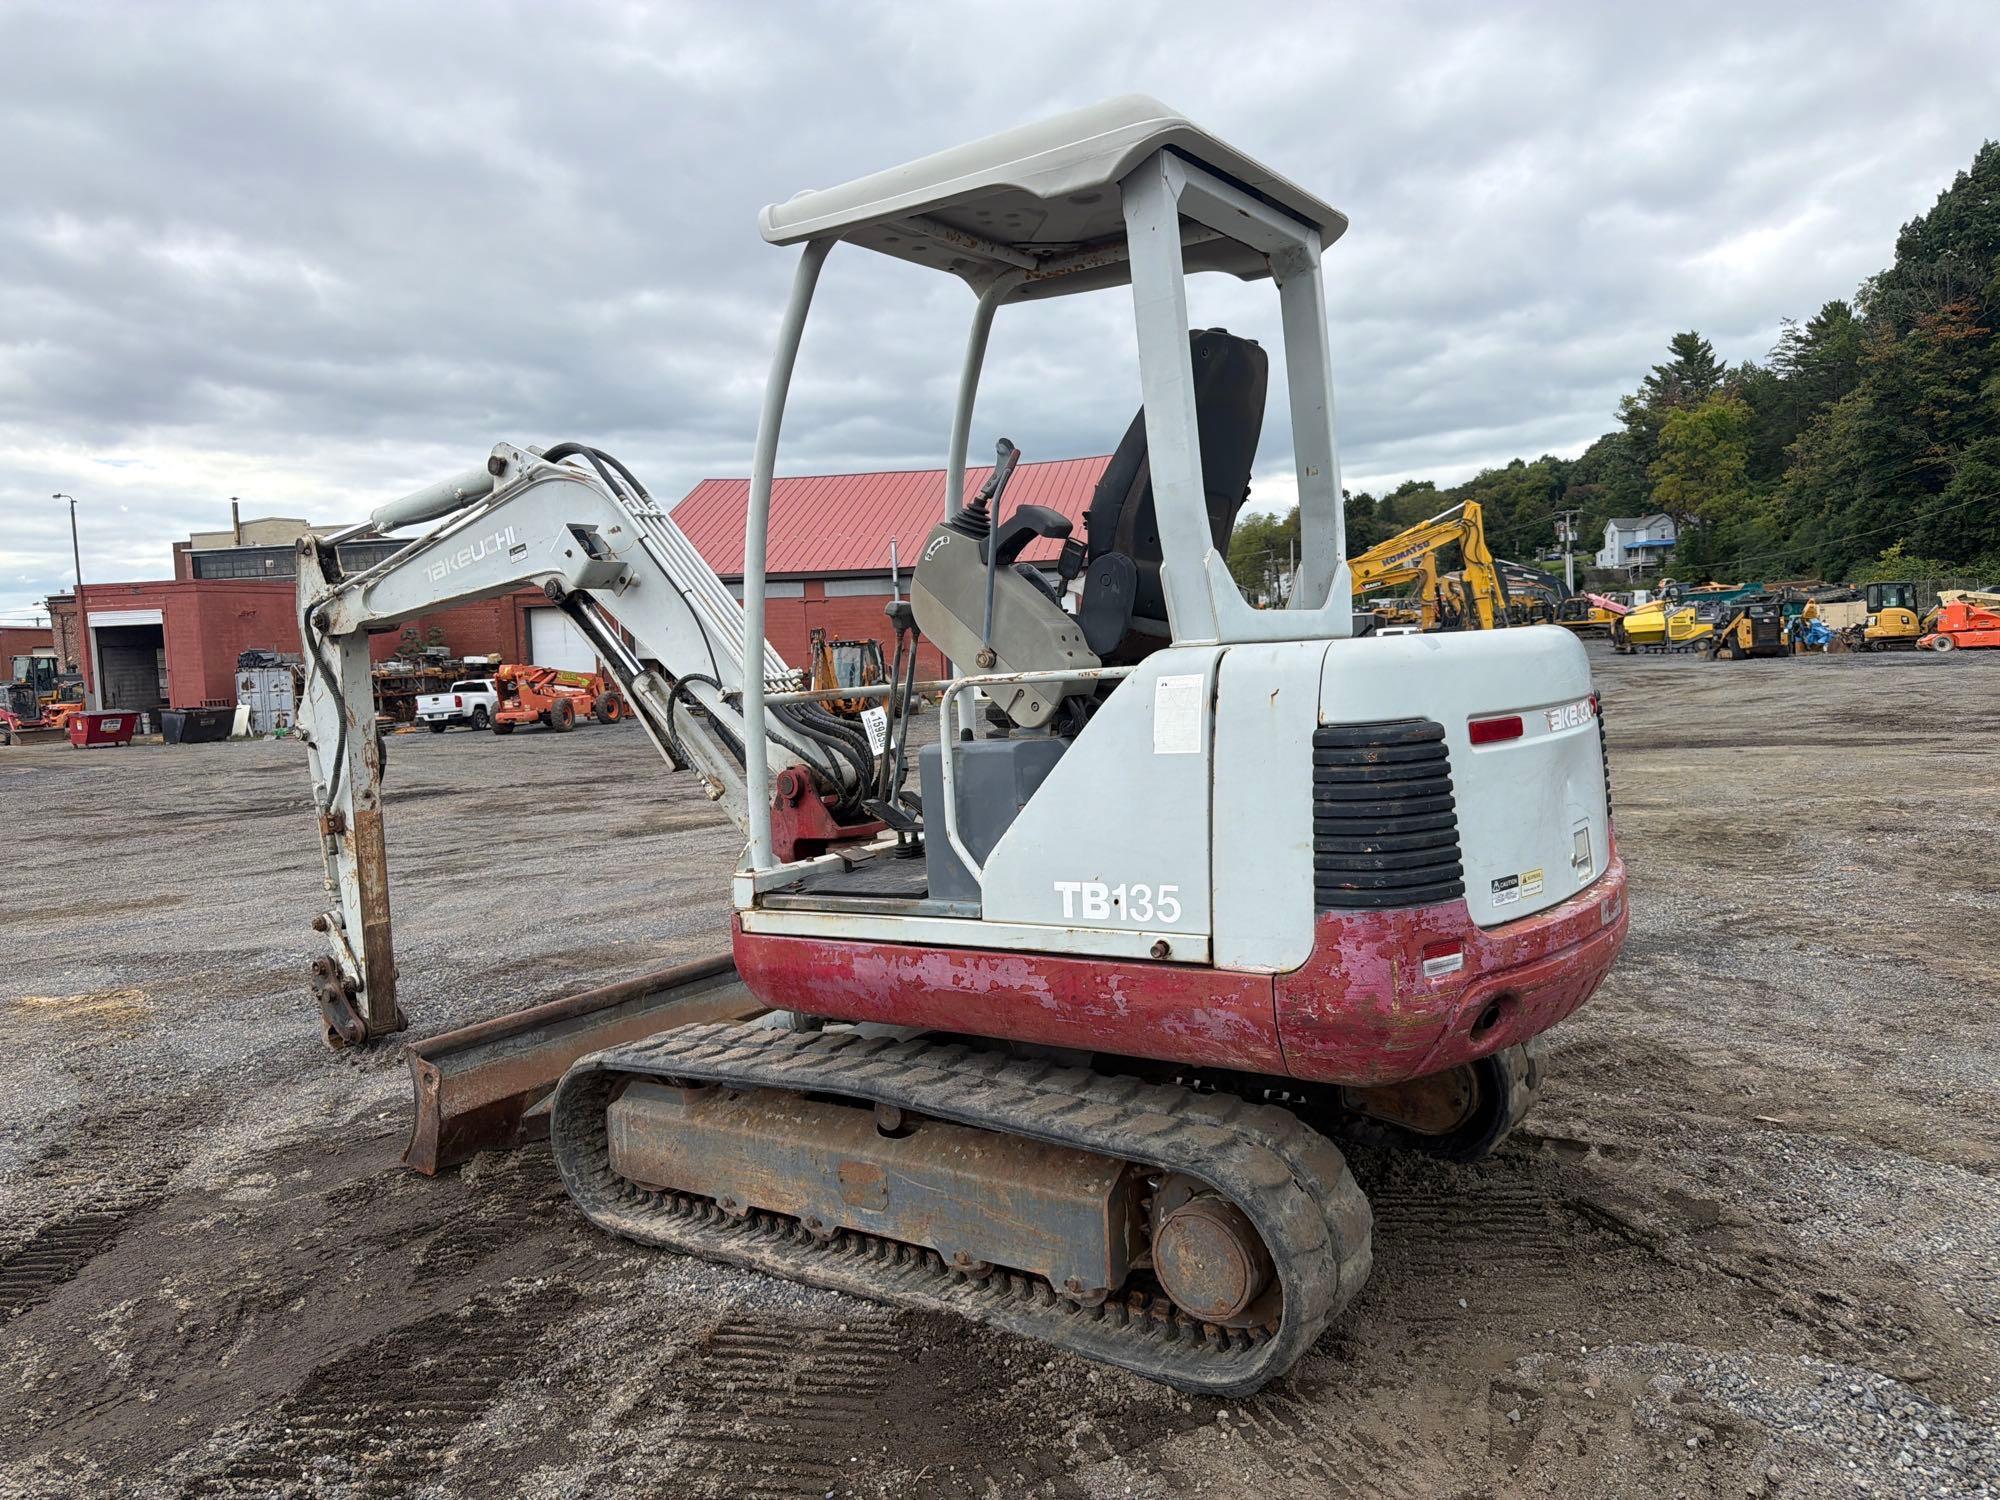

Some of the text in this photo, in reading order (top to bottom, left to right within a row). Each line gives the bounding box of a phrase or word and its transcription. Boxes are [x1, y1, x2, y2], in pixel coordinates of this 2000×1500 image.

[1381, 540, 1430, 567] KOMATSU
[1500, 878, 1518, 888] CAUTION
[1054, 880, 1182, 923] TB135
